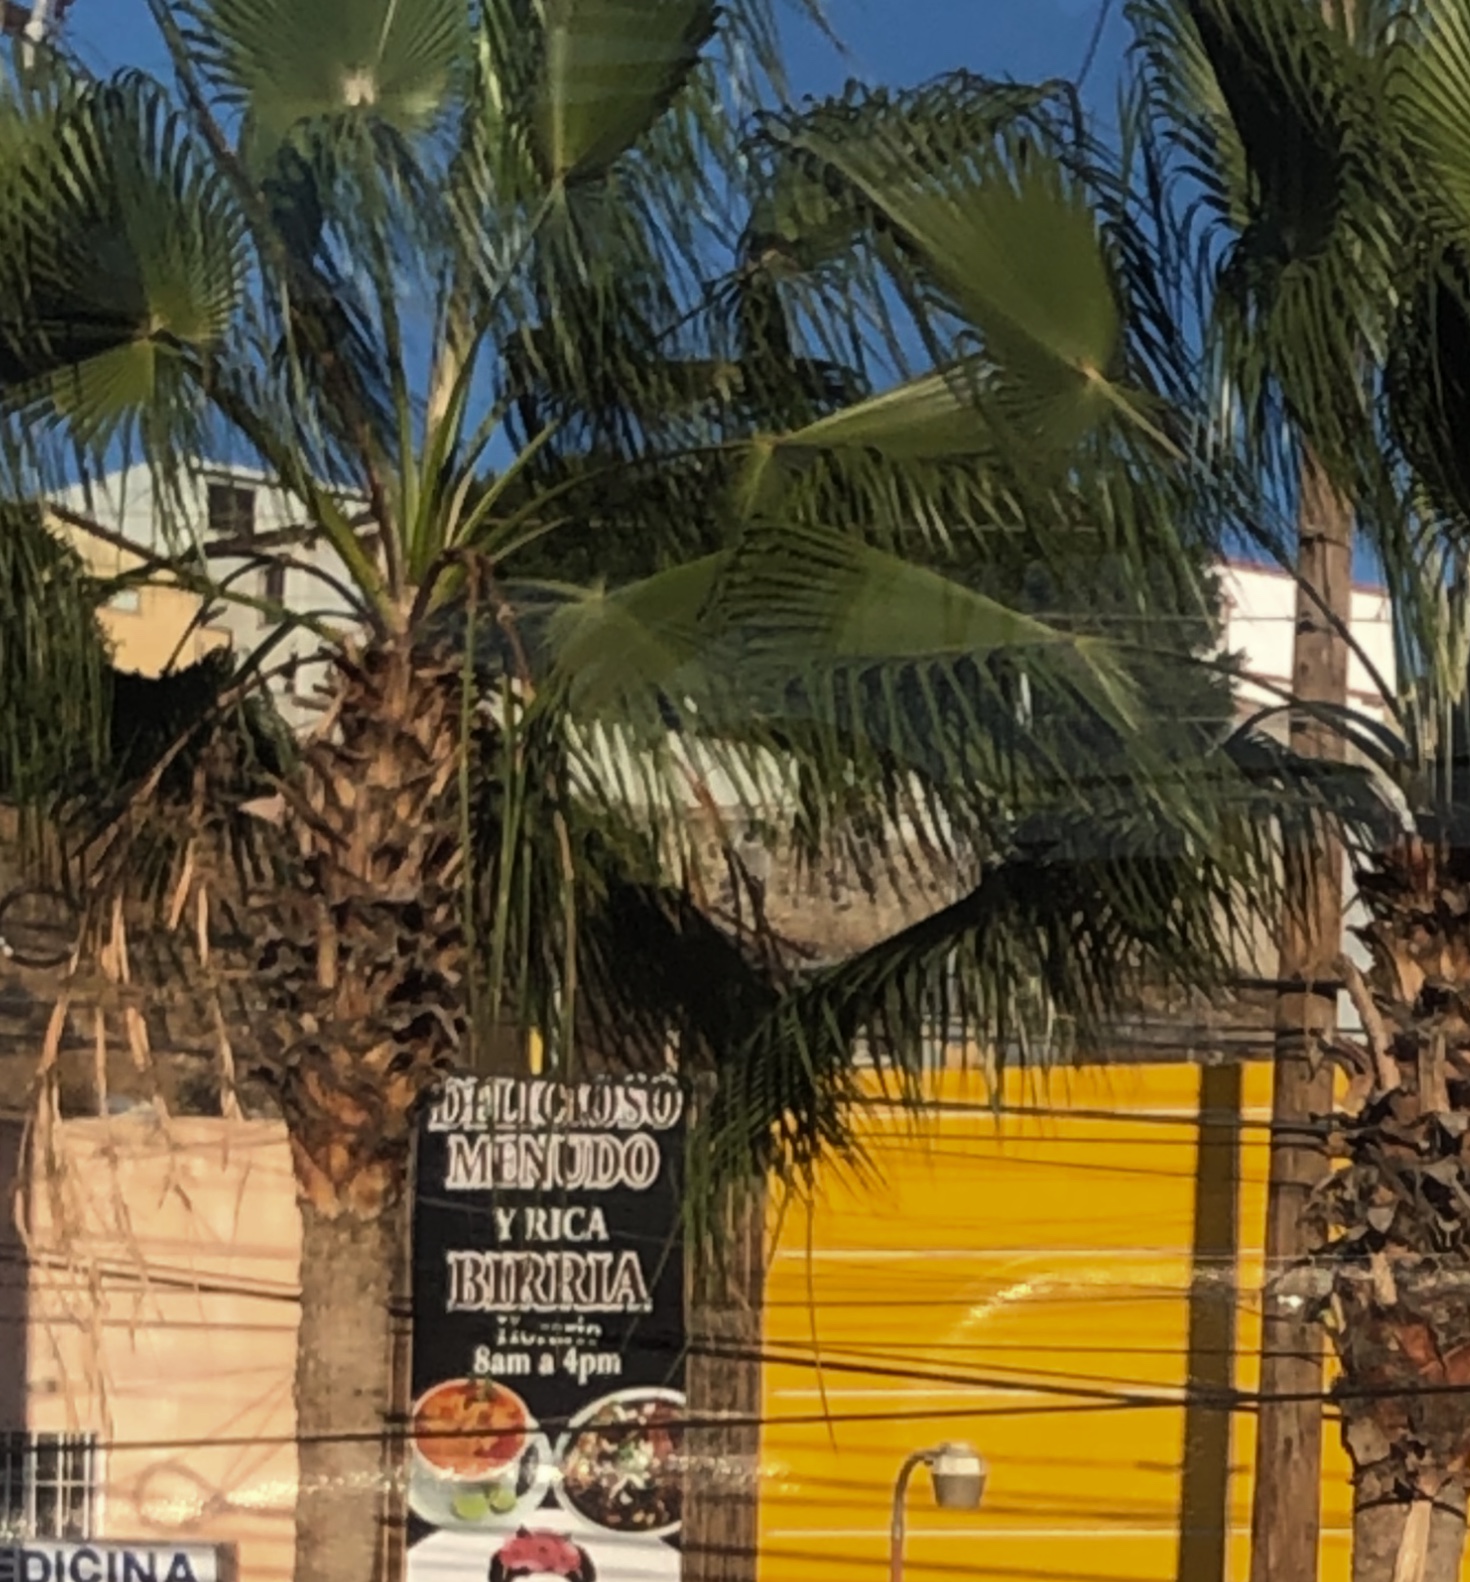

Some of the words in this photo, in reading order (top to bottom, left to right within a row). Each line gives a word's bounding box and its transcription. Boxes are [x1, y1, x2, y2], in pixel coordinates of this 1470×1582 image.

[444, 1132, 661, 1190] MENUDO
[494, 1207, 517, 1241] Y
[524, 1206, 610, 1241] RICA
[445, 1250, 653, 1312] BIRRIA
[472, 1345, 531, 1375] 8am
[538, 1352, 555, 1376] a
[562, 1346, 621, 1386] 4pm
